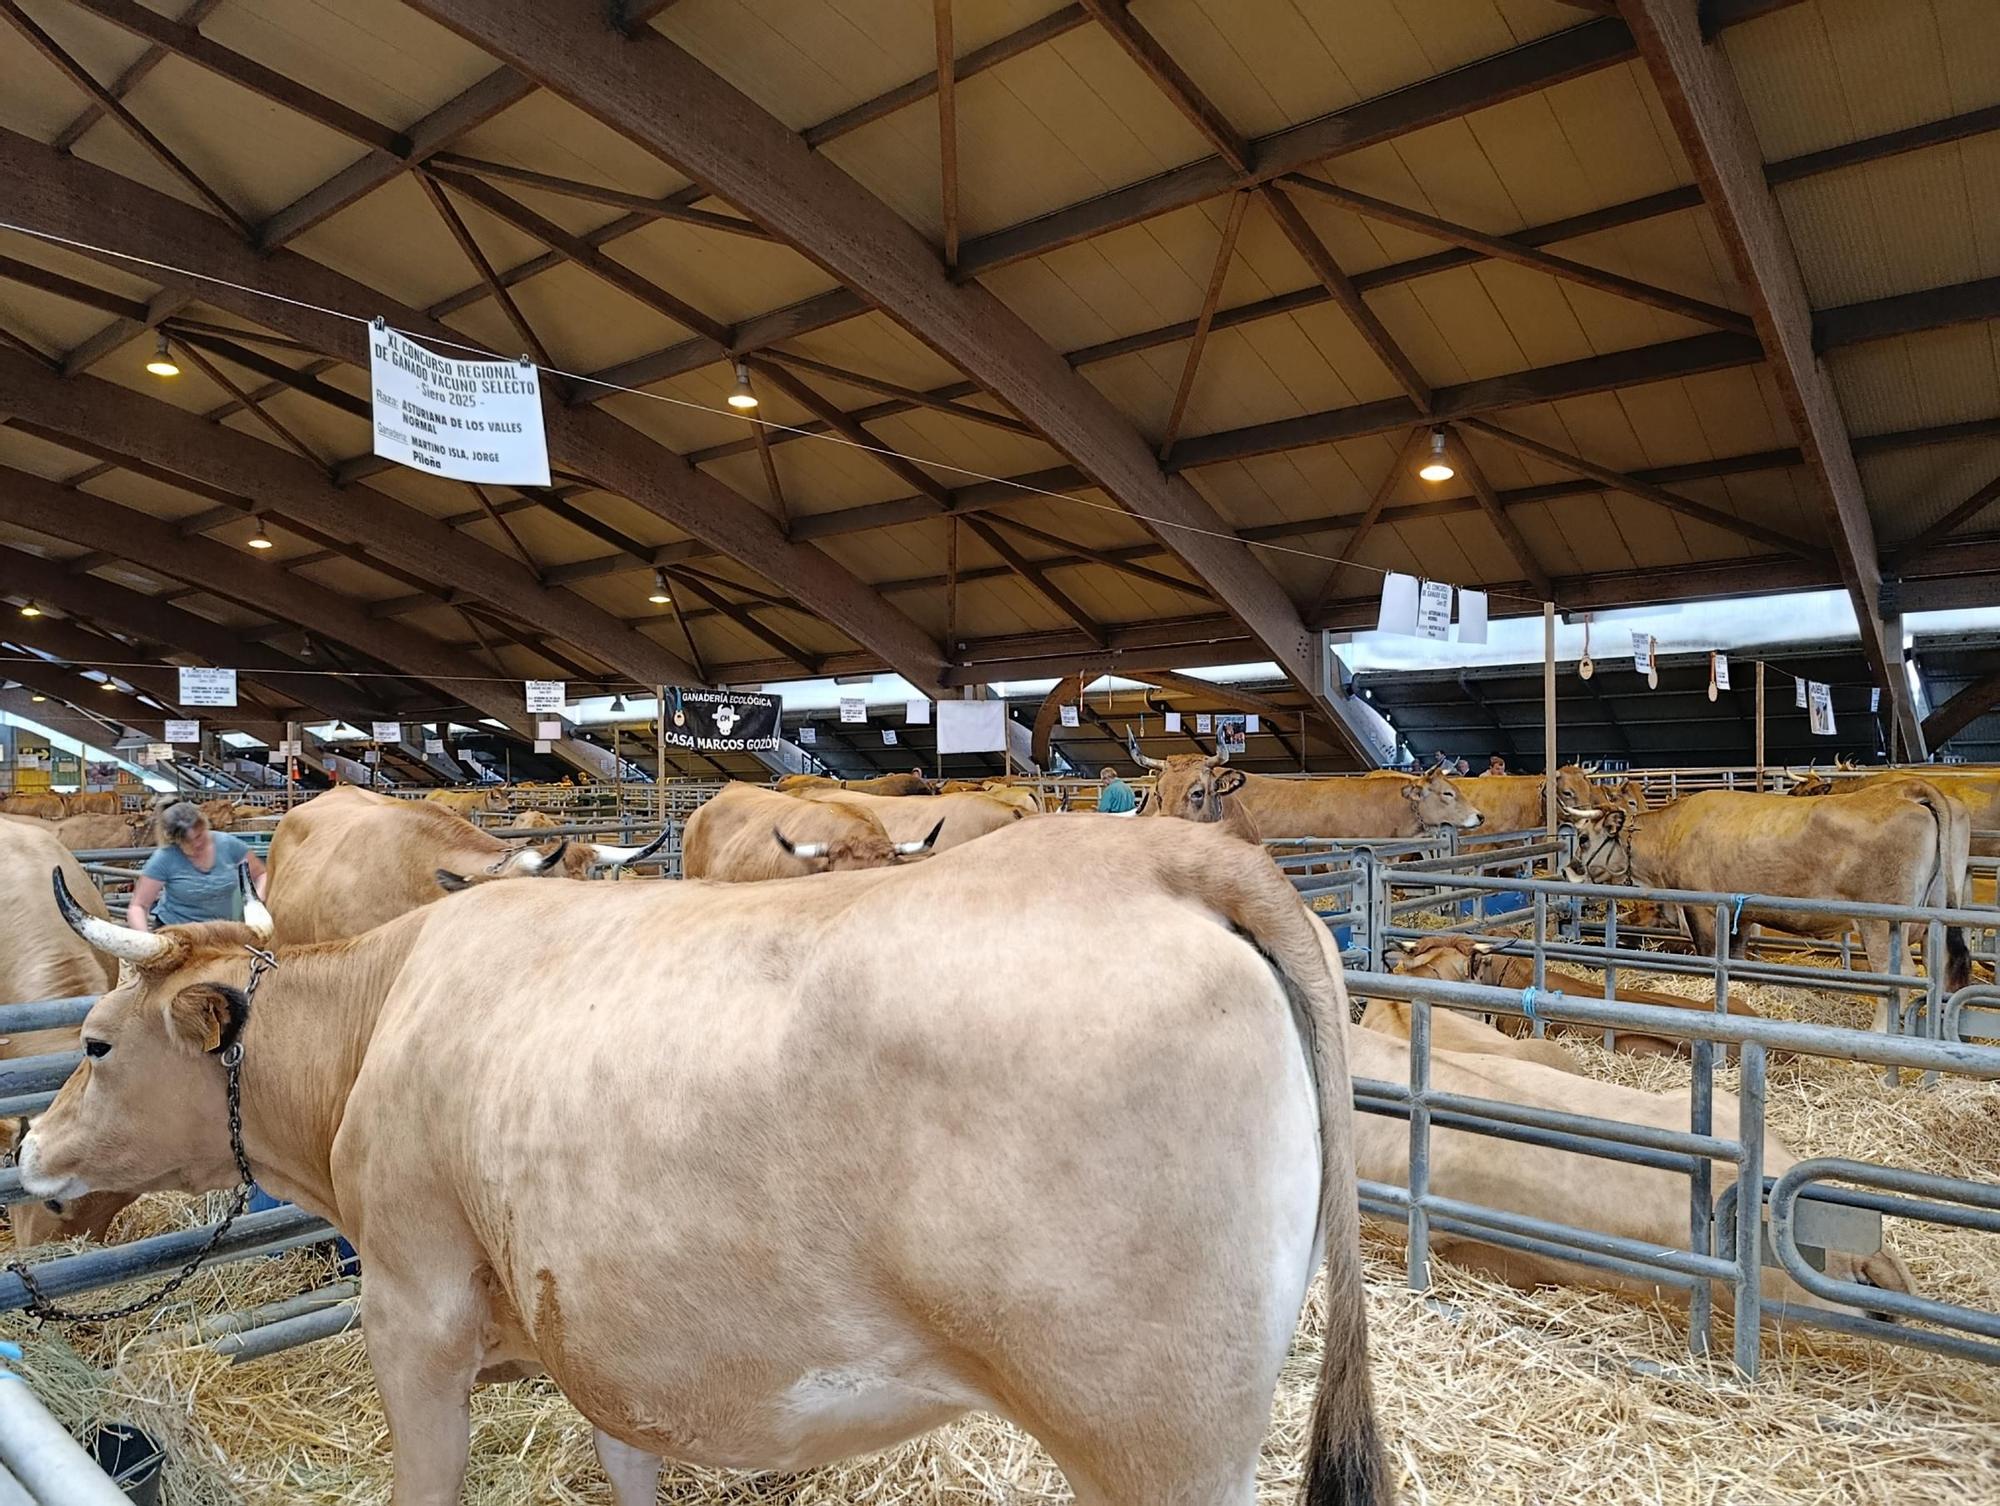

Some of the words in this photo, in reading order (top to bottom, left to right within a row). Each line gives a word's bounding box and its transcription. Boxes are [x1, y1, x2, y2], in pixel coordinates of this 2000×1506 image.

[387, 333, 399, 352] XL
[402, 341, 453, 376] CONCURSO
[457, 364, 518, 380] REGIONAL
[374, 343, 389, 361] DE
[392, 351, 429, 381] GANADO
[430, 371, 477, 394] VACUNO
[481, 380, 536, 396] SELECTO
[421, 382, 446, 403] Siero
[448, 392, 477, 408] 2025
[402, 399, 448, 426] ASTURIANA
[450, 416, 463, 430] DE
[465, 420, 485, 433] LOS
[487, 421, 523, 434] VALLES
[402, 411, 438, 435] NORMAL
[411, 435, 446, 455] MARTINO
[472, 451, 500, 463] JORGE
[412, 450, 442, 470] Piloña
[682, 692, 729, 704] GANADERÍA
[729, 694, 772, 708] ECOLÓGICA
[720, 714, 730, 722] CM
[665, 731, 695, 748] CASA
[697, 737, 744, 751] MARCOS
